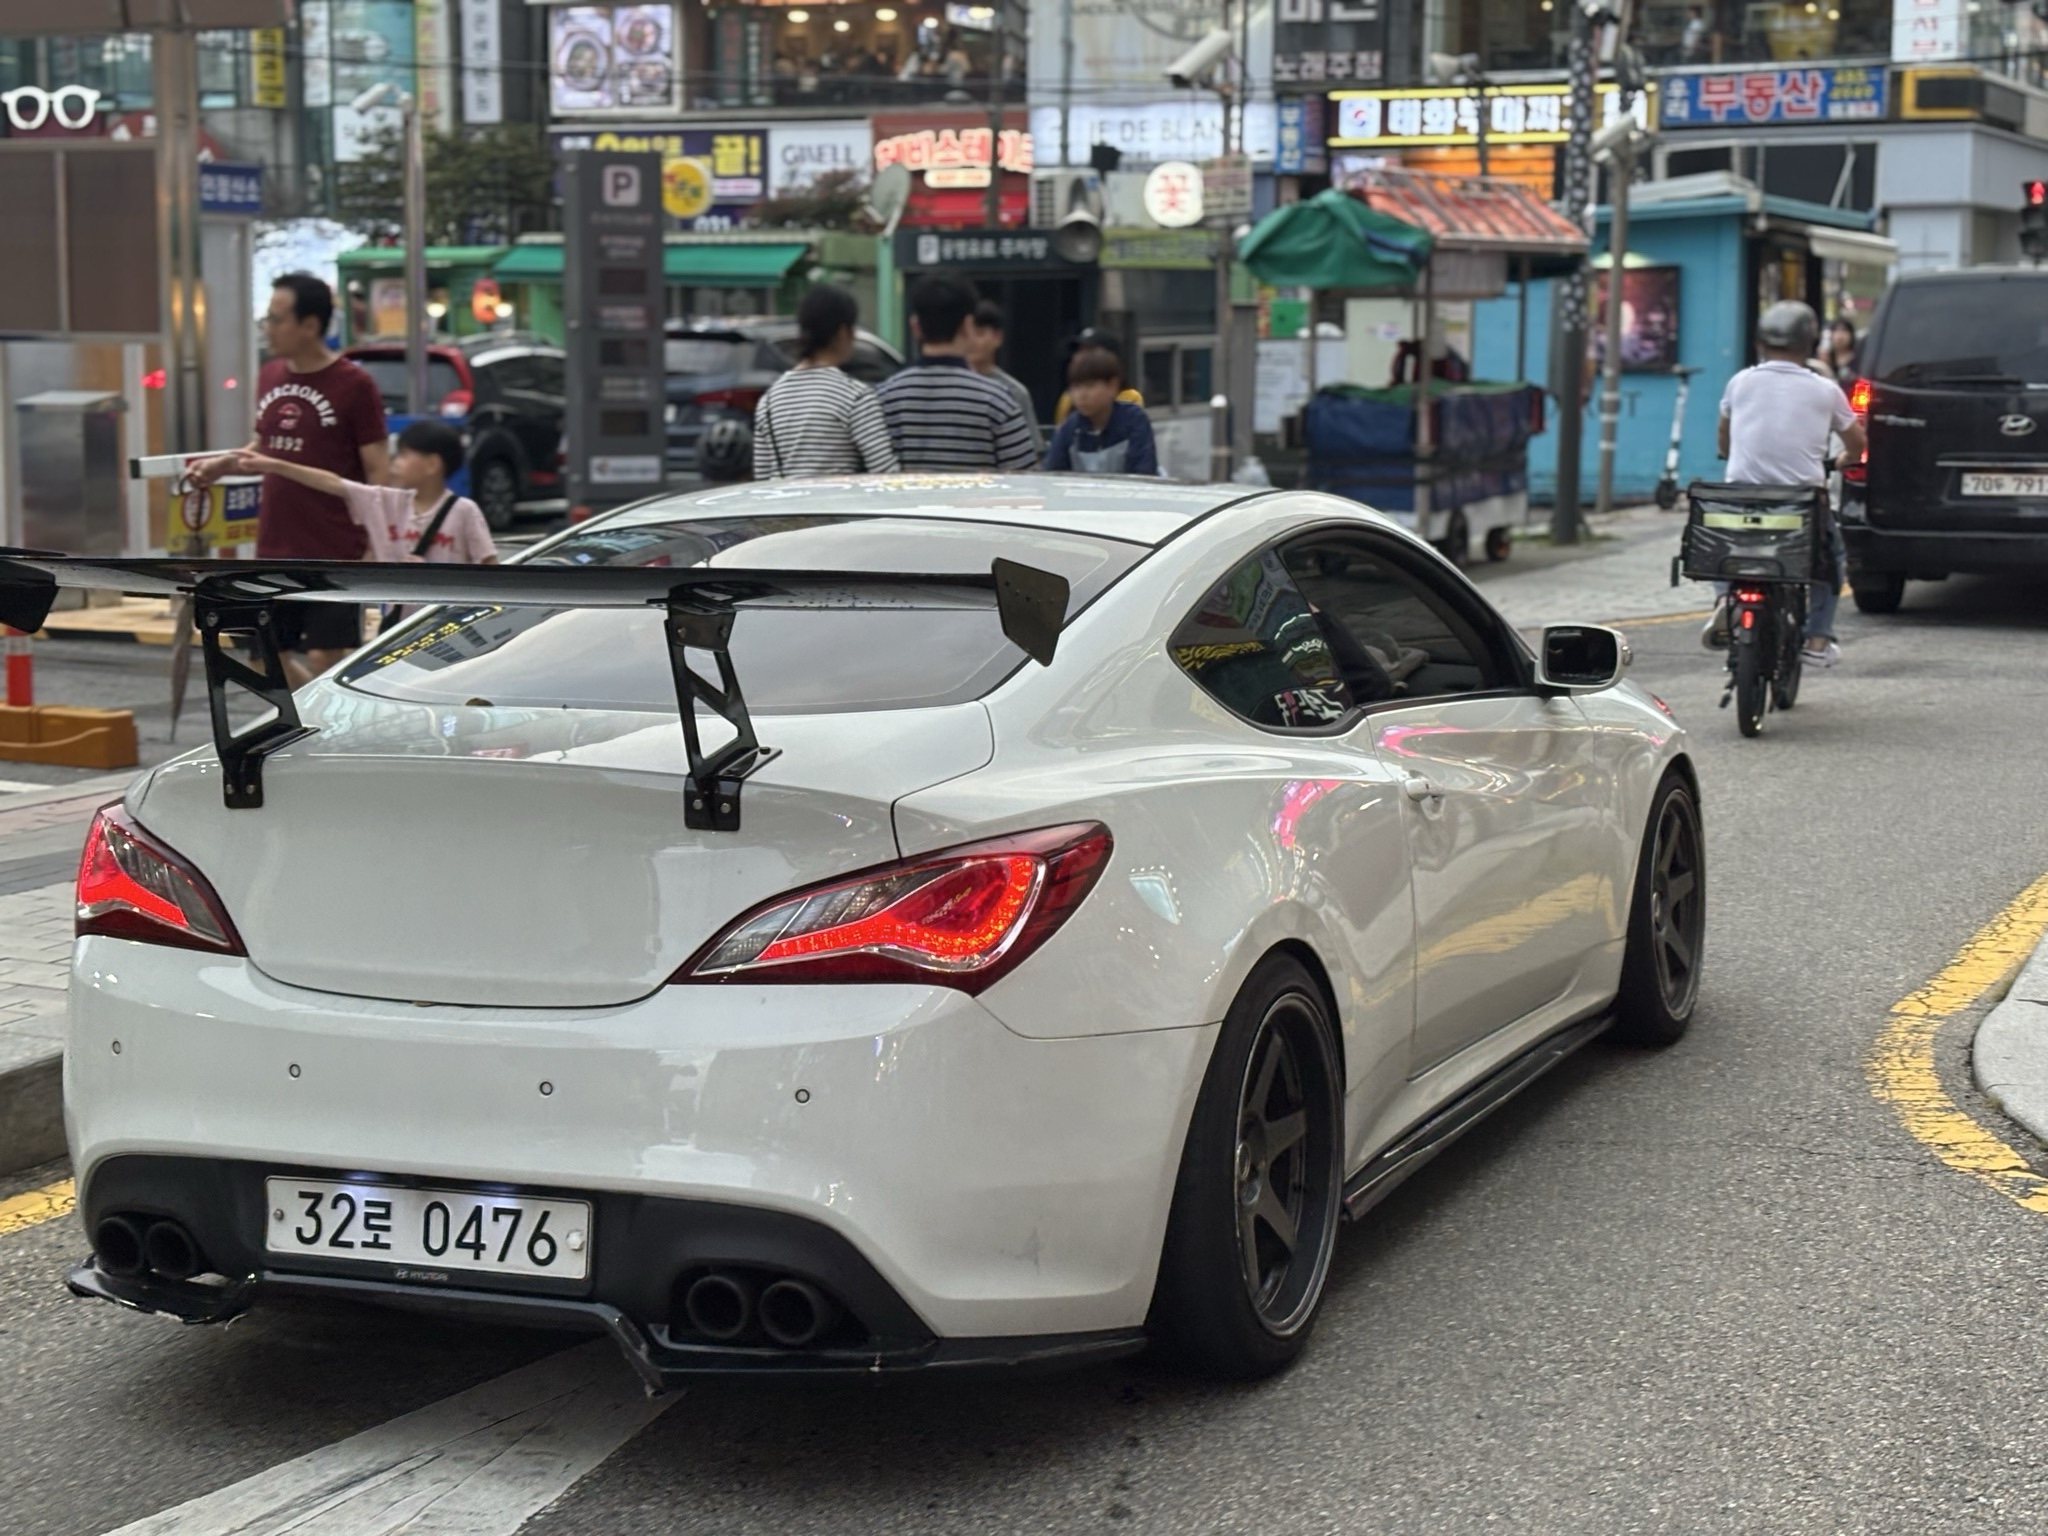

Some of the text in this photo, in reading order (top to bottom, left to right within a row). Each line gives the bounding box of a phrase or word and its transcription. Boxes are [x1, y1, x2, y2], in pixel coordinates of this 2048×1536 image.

[1275, 51, 1382, 81] 노래주점
[1699, 70, 1826, 122] 부동산
[611, 171, 632, 200] P
[1156, 173, 1191, 214] 꽃
[268, 434, 305, 452] 1892
[2012, 476, 2048, 493] 791
[295, 1189, 558, 1267] 32로 0476
